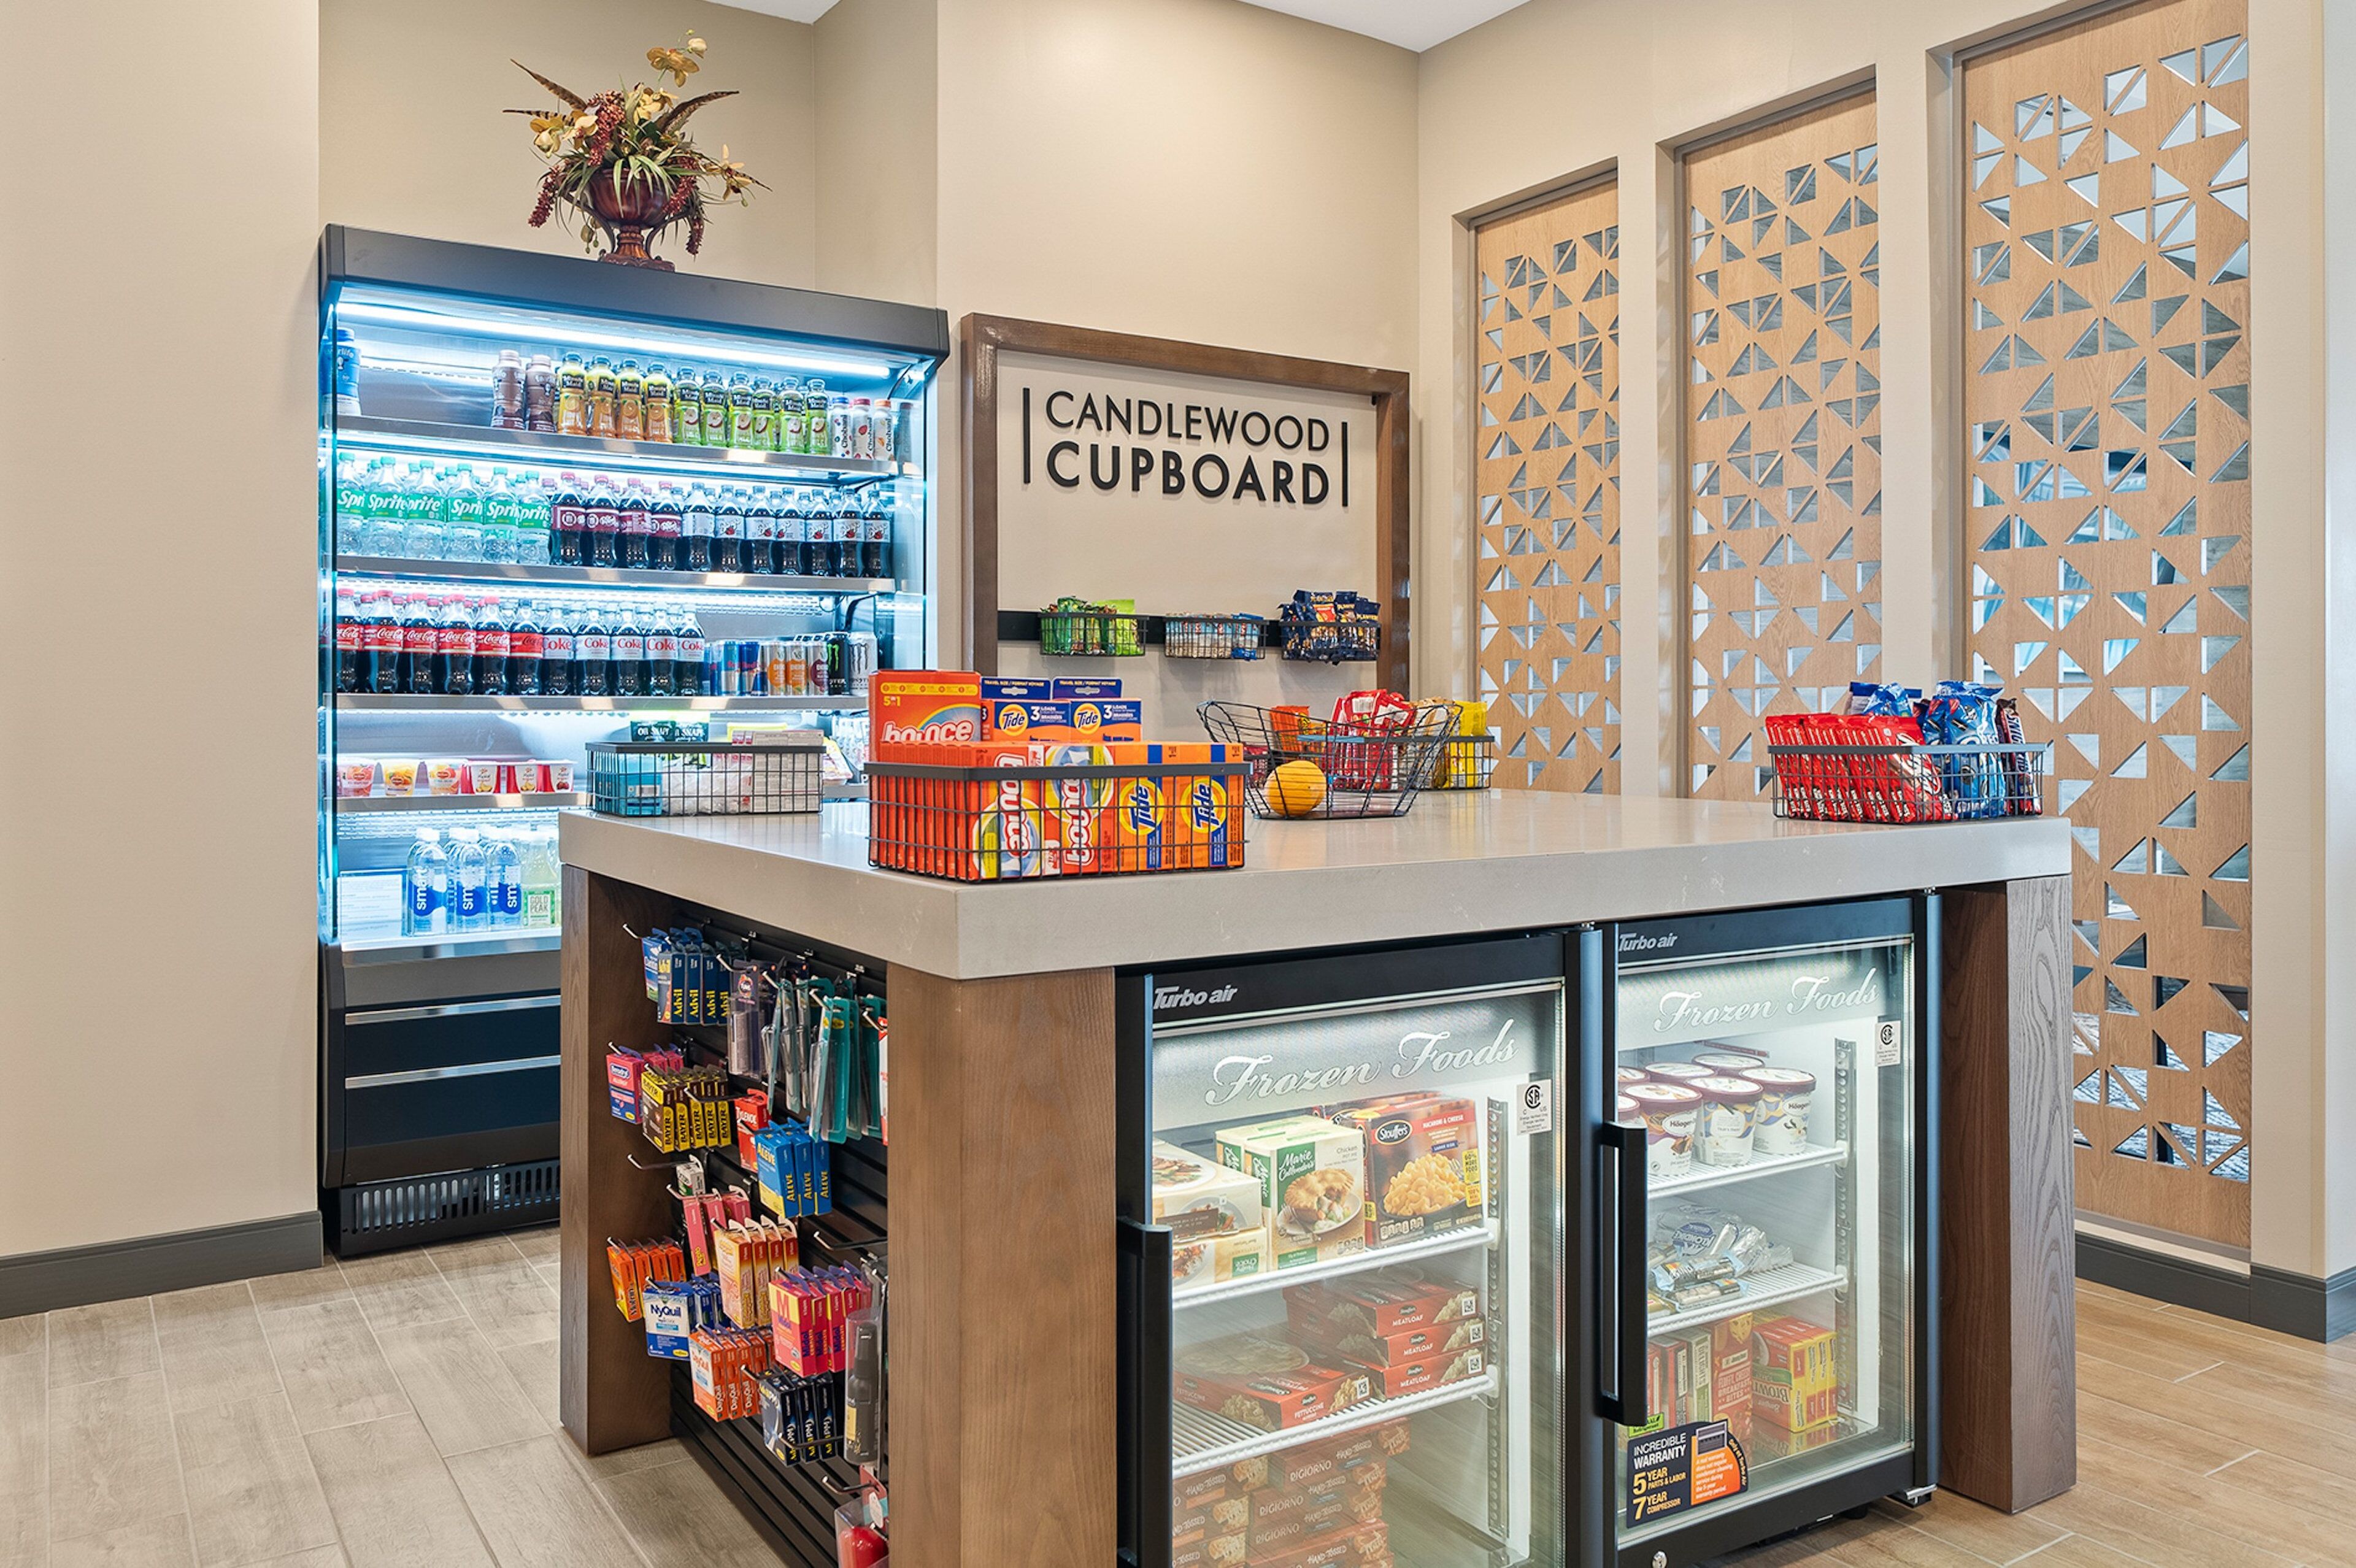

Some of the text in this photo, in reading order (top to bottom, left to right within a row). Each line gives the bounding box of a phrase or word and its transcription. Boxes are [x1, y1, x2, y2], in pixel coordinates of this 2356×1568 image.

[1046, 391, 1329, 452] CANDLEWOOD
[1047, 440, 1329, 505] CUPBOARD
[338, 490, 364, 508] Spri
[407, 496, 441, 511] prite
[451, 499, 483, 516] Spri
[486, 501, 517, 518] Spri
[519, 505, 549, 521] prite
[543, 637, 571, 650] Coke
[584, 637, 609, 649] Coke
[617, 637, 642, 649] Coke
[647, 637, 676, 651] Coke
[681, 640, 704, 651] Coke
[1002, 712, 1025, 731] Tide
[1031, 706, 1041, 721] 3
[1077, 711, 1098, 729] Tide
[1103, 705, 1113, 720] 3
[1130, 785, 1157, 831] Tide
[1193, 783, 1221, 829] Tide
[530, 896, 549, 904] GOLD
[530, 904, 549, 913] PEAK
[1619, 932, 1678, 952] Turbo air
[674, 988, 683, 1017] Advil
[689, 989, 698, 1018] Advil
[706, 990, 717, 1018] Advil
[1153, 984, 1238, 1010] Turbo air
[1653, 967, 1880, 1033] Frozen Foods
[1205, 1018, 1519, 1105] Frozen Foods
[693, 1110, 702, 1140] BAYER
[1379, 1125, 1409, 1141] Stouffer's
[757, 1142, 777, 1166] ALEVE
[1279, 1149, 1314, 1170] Marie
[1337, 1145, 1358, 1155] Chicken
[785, 1173, 796, 1202] ALEVE
[803, 1172, 812, 1200] ALEVE
[820, 1170, 829, 1198] ALEVE
[650, 1304, 682, 1318] NyQuil
[1392, 1314, 1423, 1327] MEATLOAF
[801, 1331, 810, 1358] Midol
[833, 1326, 841, 1353] Midol
[1403, 1343, 1433, 1356] MEATLOAF
[1400, 1374, 1430, 1387] MEATLOAF
[1294, 1402, 1325, 1420] FETTUCCINE
[1633, 1432, 1687, 1456] INCREDIBLE
[1633, 1445, 1687, 1470] WARRANTY
[1633, 1467, 1668, 1495] 5 YEAR
[1669, 1472, 1687, 1485] LABOR
[1633, 1491, 1668, 1521] 7 YEAR
